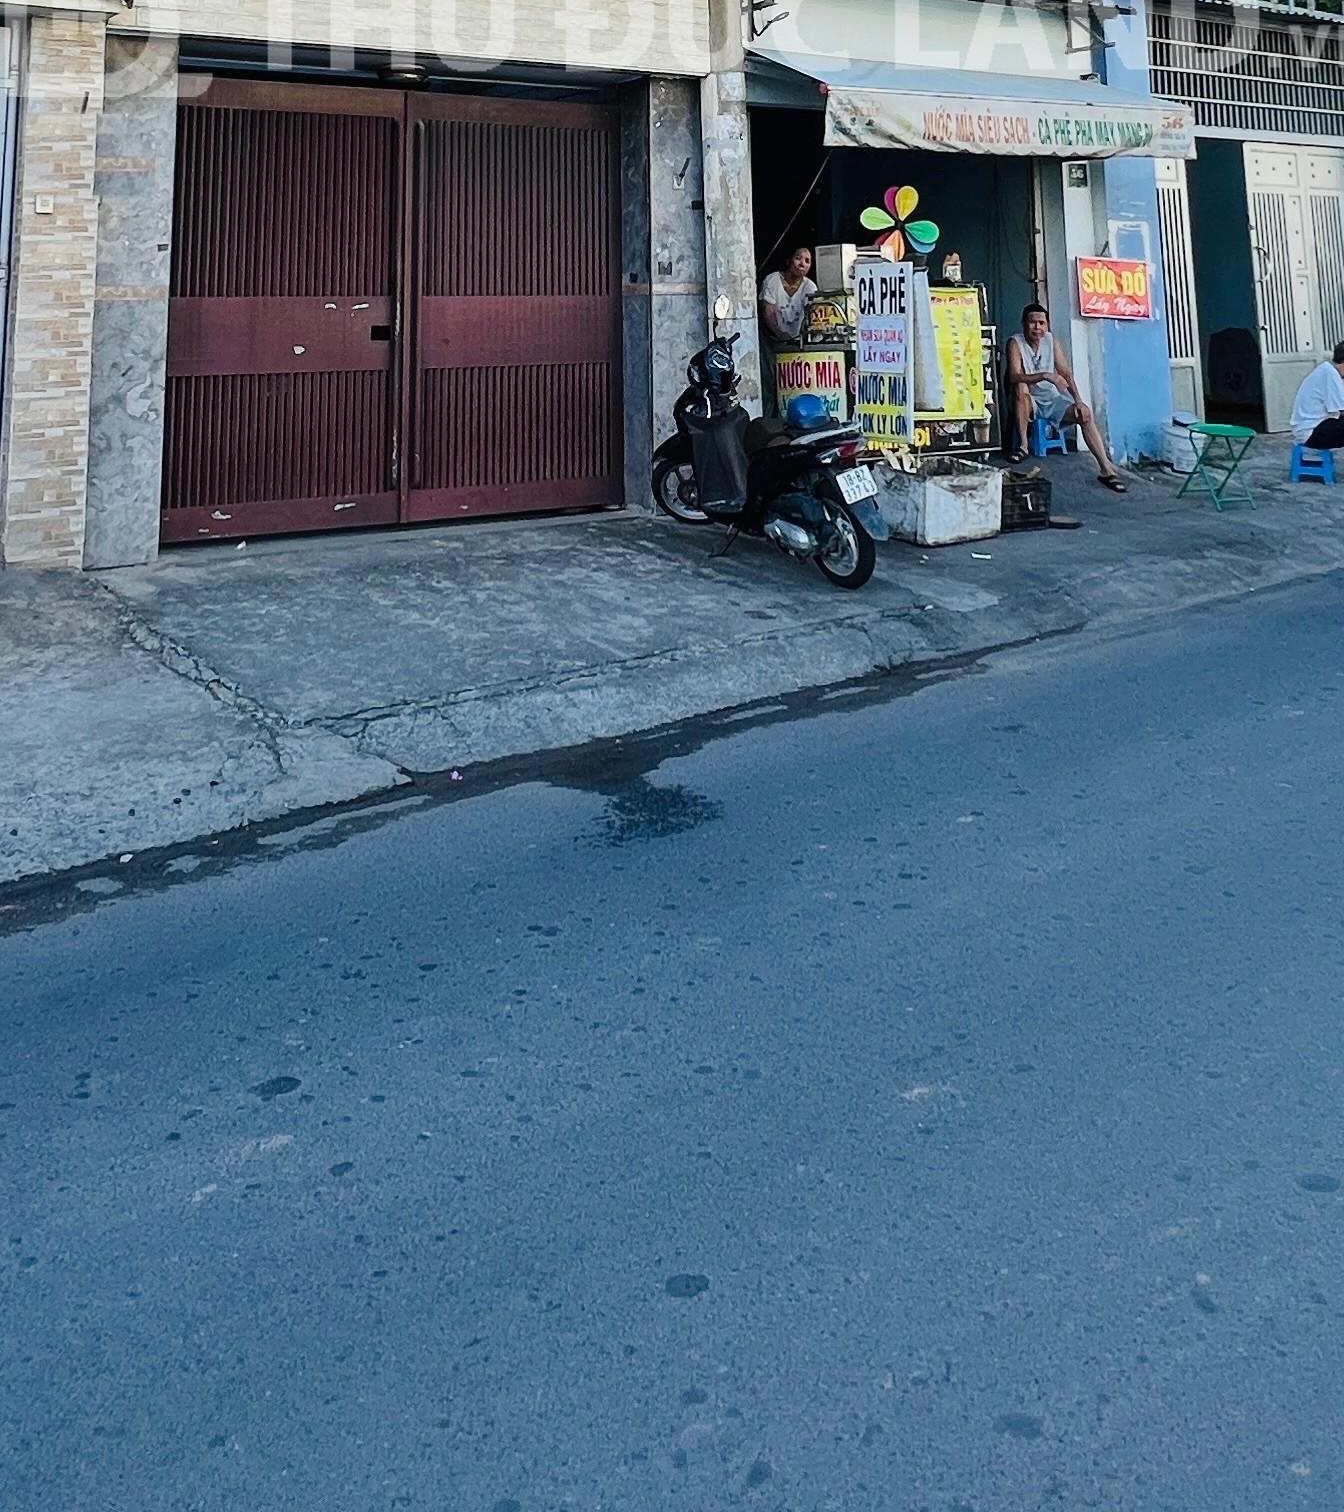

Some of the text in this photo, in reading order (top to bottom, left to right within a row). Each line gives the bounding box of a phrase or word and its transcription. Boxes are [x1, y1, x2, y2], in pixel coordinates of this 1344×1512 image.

[859, 268, 905, 314] CÀ PHÊ
[778, 356, 841, 388] NƯỚC MÍA
